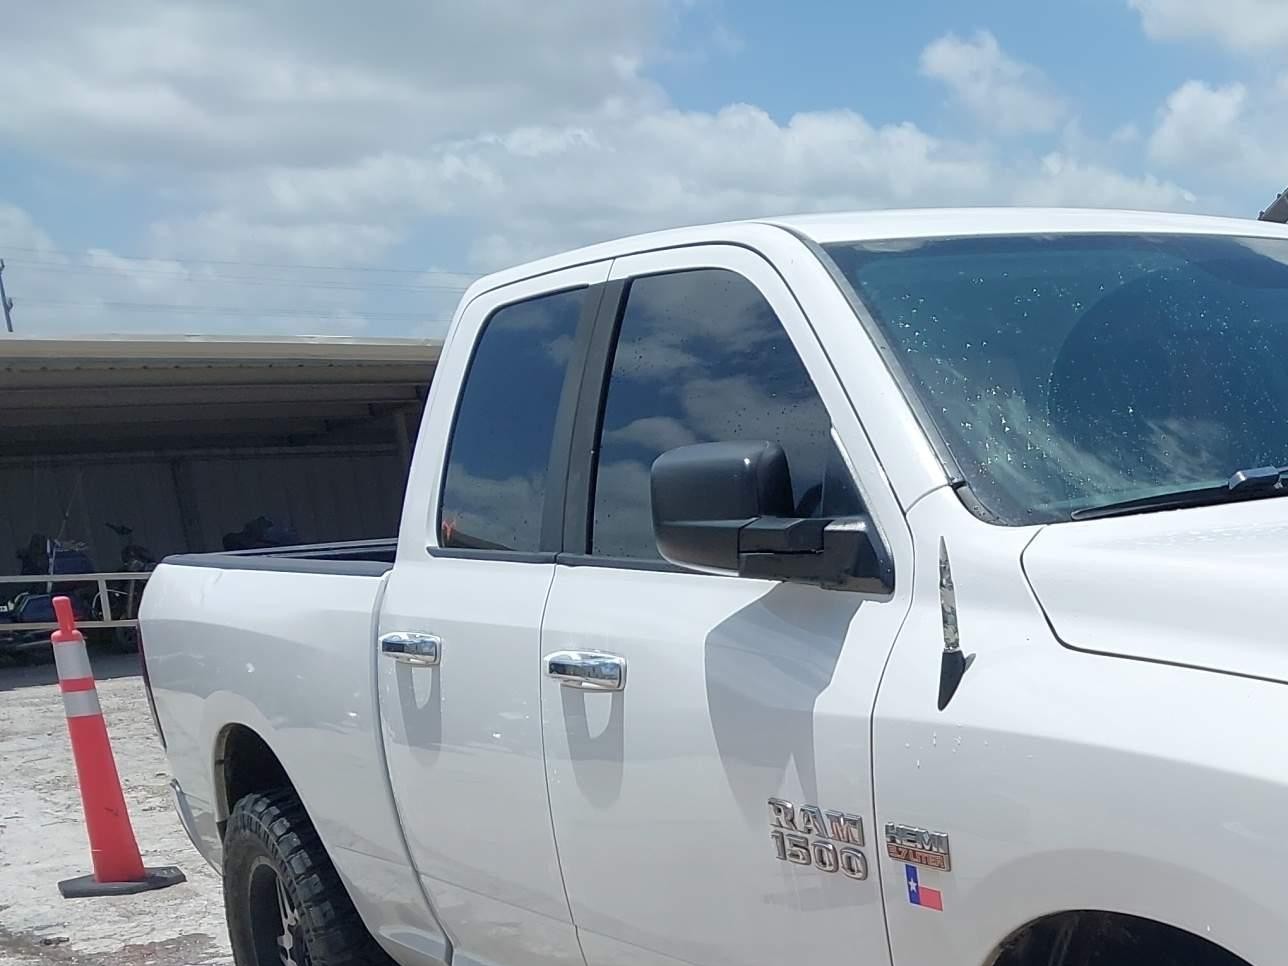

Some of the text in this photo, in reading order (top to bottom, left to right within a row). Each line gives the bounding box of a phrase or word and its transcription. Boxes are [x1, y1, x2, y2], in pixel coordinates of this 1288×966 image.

[768, 797, 865, 847] RAM
[884, 822, 949, 854] HEMI
[770, 829, 868, 881] 1500
